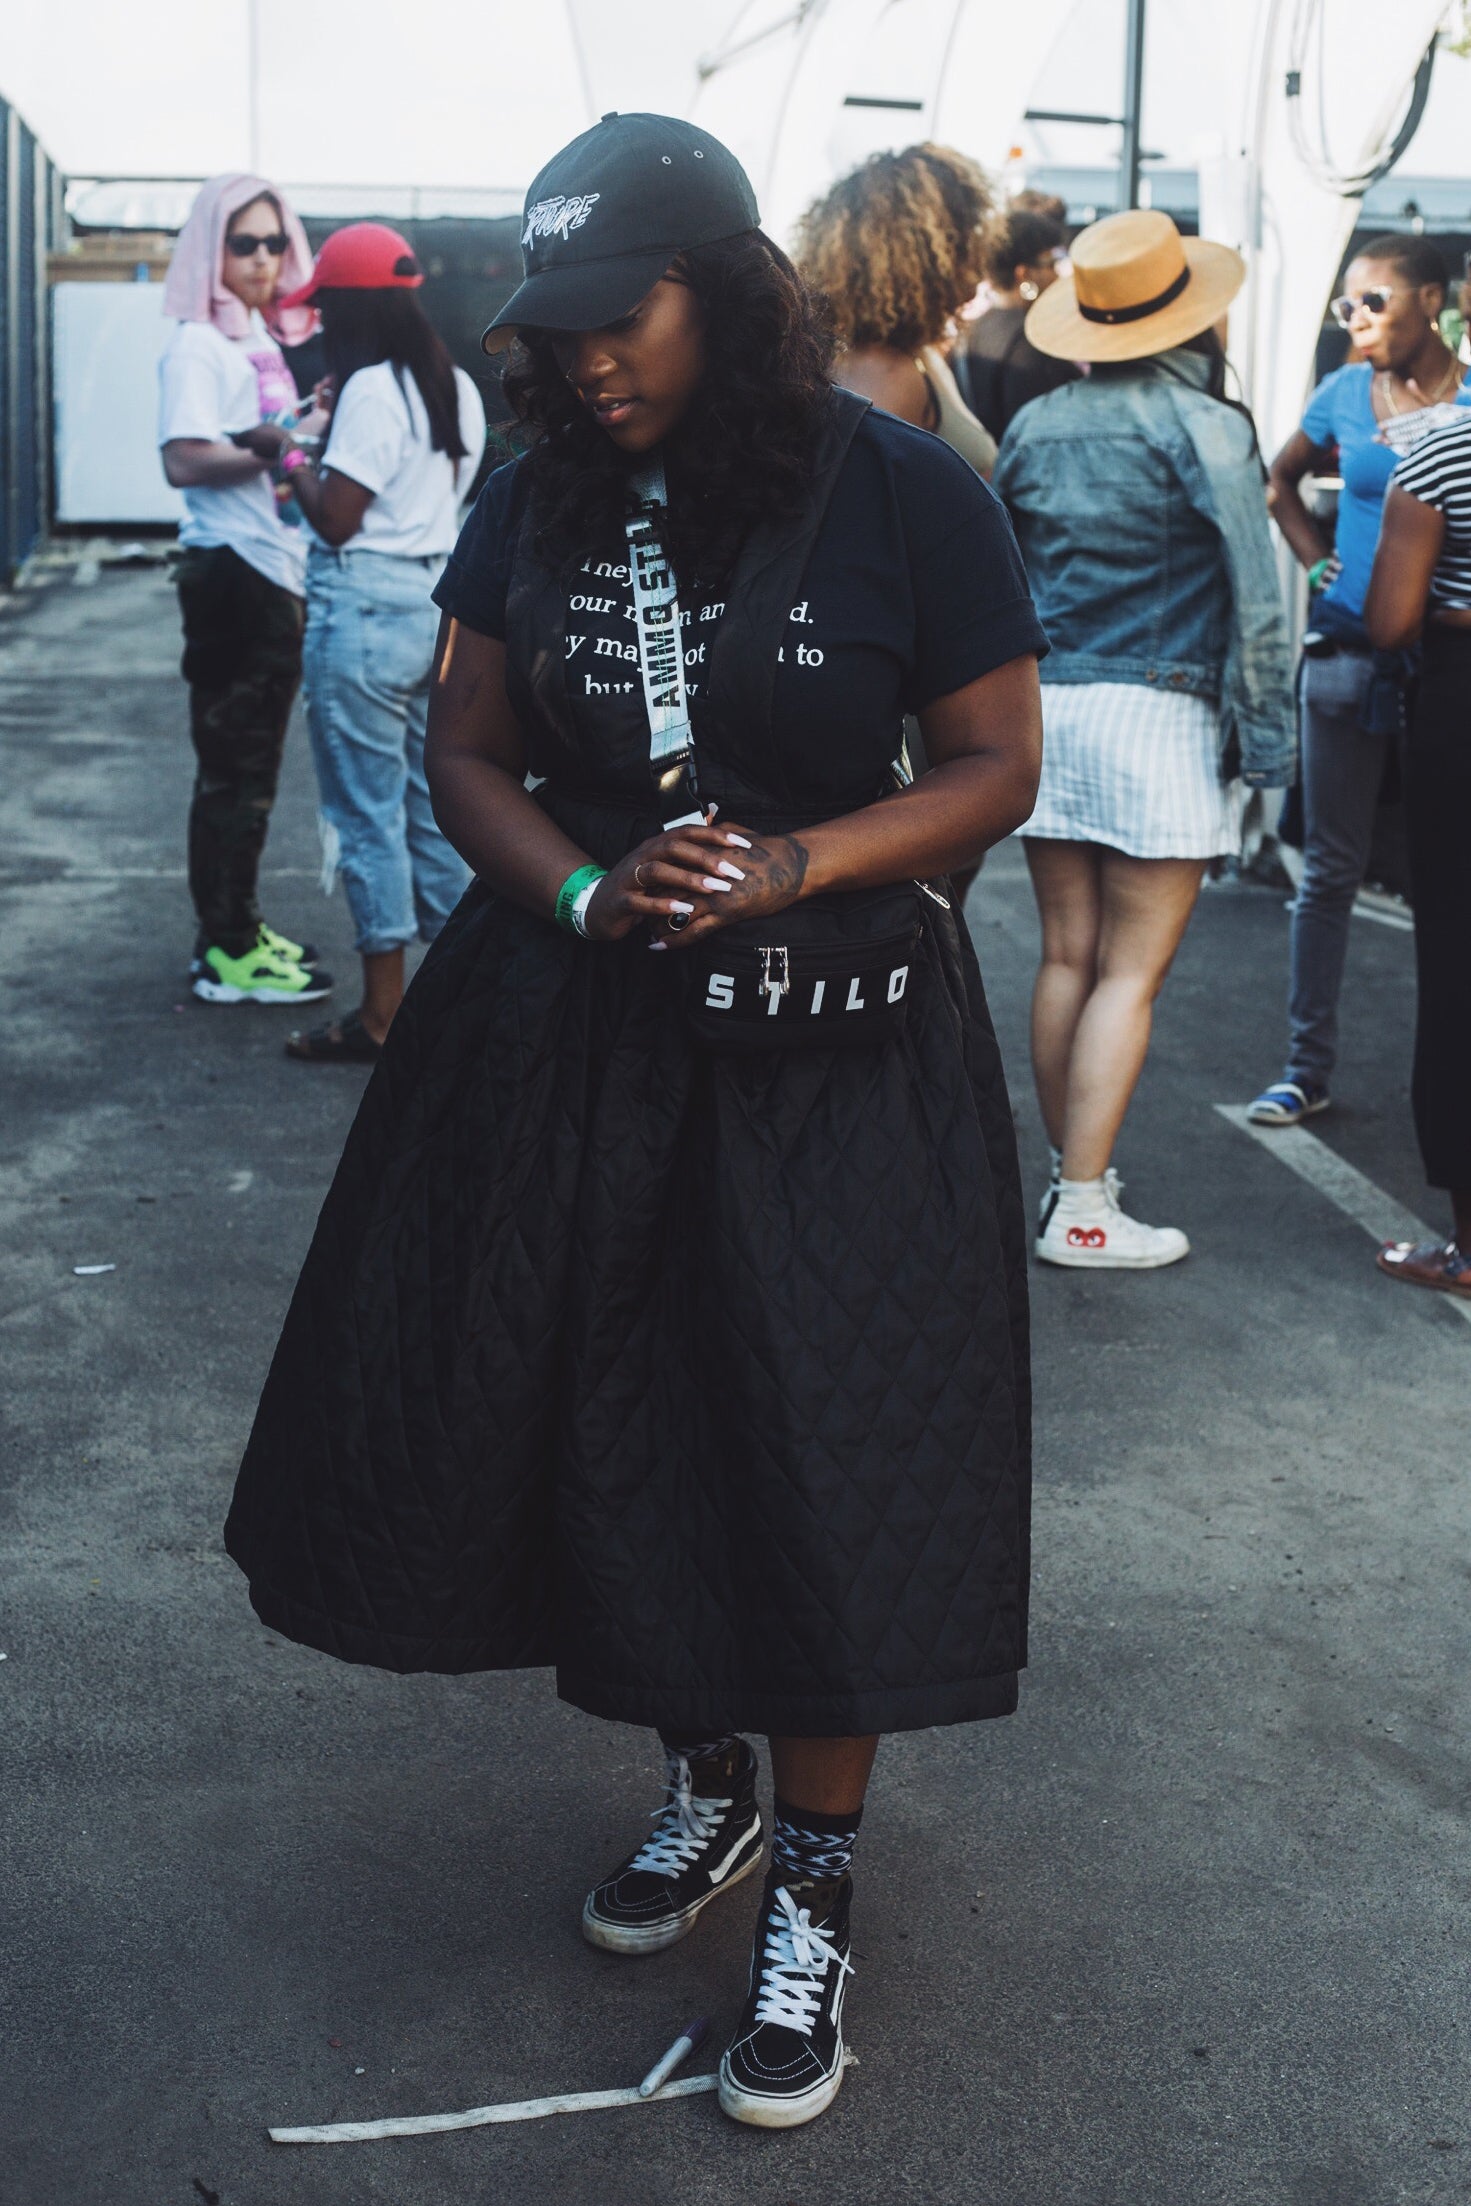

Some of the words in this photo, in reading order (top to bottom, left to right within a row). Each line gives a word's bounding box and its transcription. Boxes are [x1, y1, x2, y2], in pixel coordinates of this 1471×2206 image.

[642, 604, 681, 708] AMMO
[796, 642, 824, 667] to
[705, 965, 909, 1016] STILO
